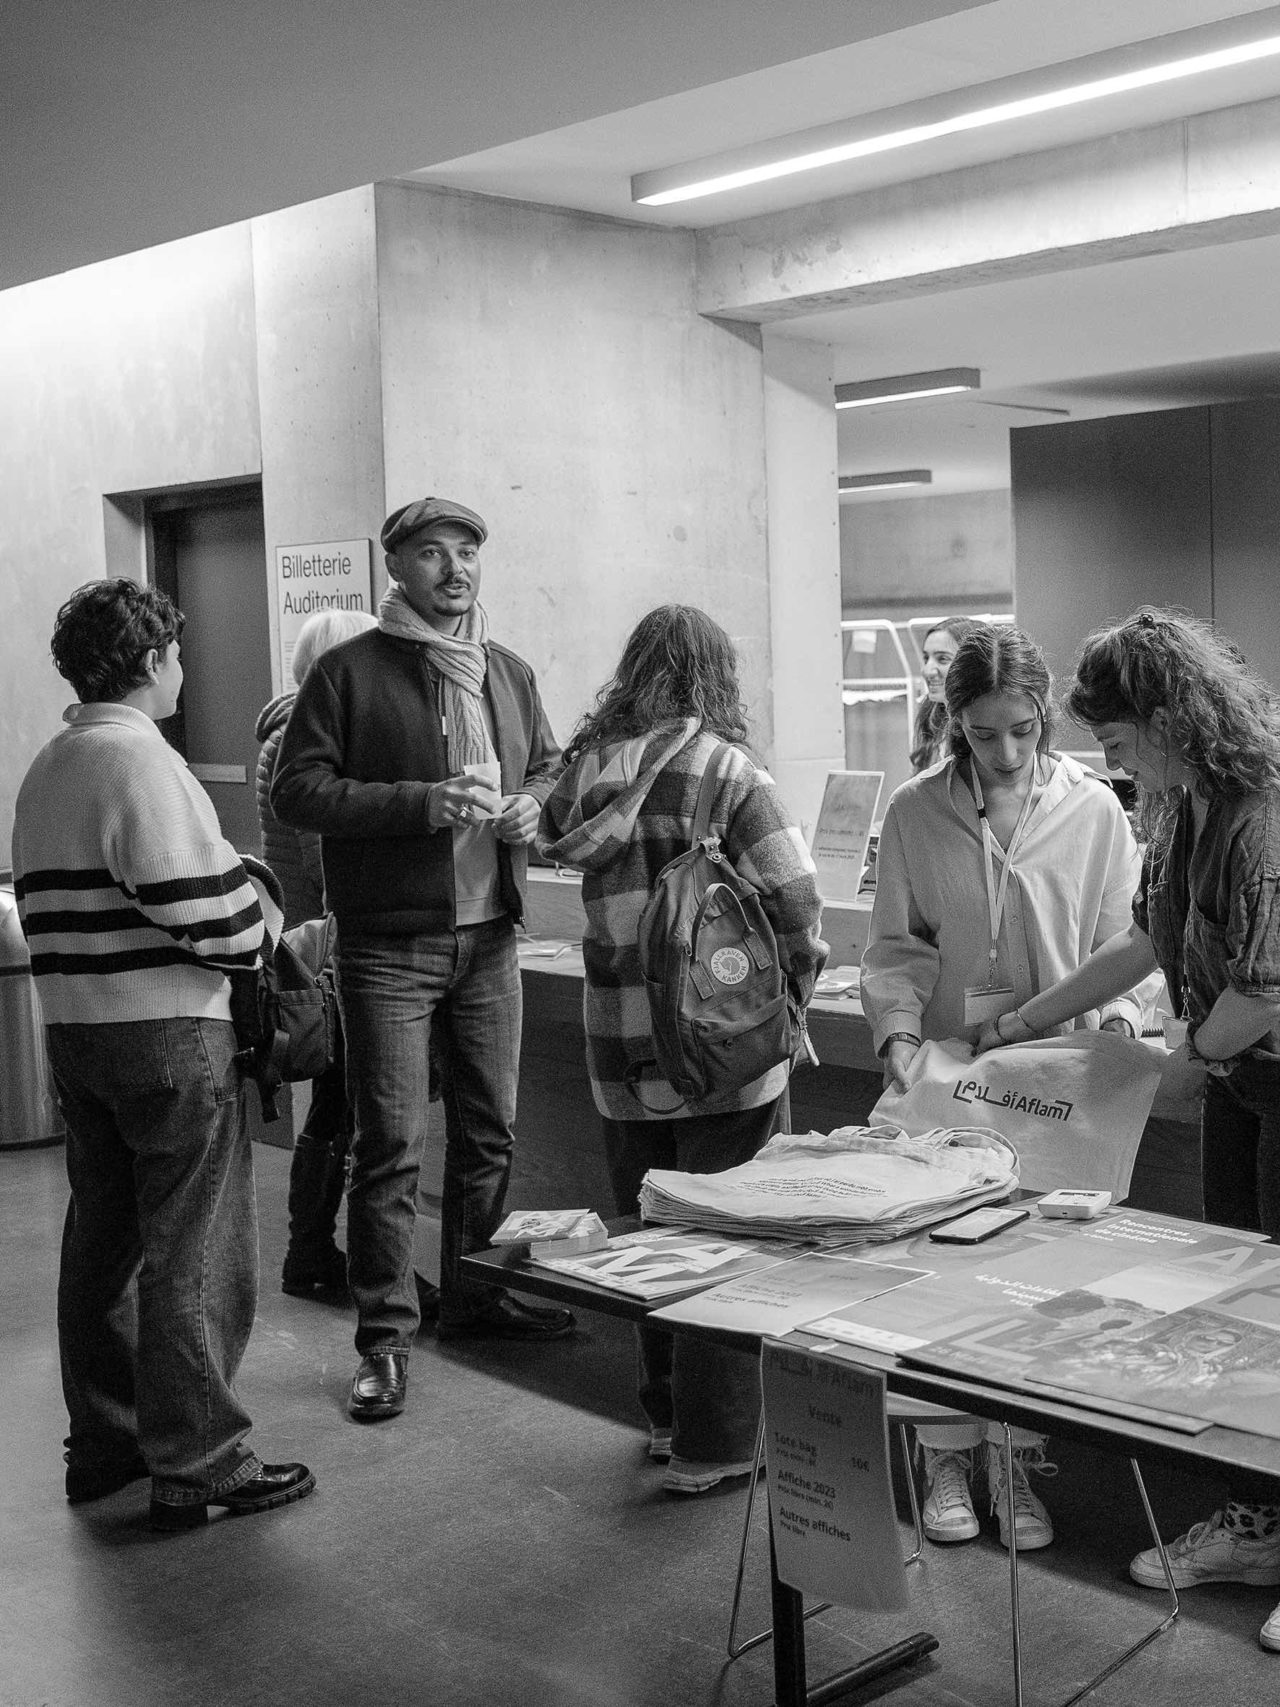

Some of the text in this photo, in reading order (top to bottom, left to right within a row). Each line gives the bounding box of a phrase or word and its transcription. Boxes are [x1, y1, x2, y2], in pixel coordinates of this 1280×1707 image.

[282, 552, 352, 579] Billetterie
[283, 588, 364, 615] Auditorium
[1015, 1096, 1064, 1120] Aflam
[778, 1469, 836, 1499] Affiche 2023
[780, 1507, 851, 1542] Autres affiches
